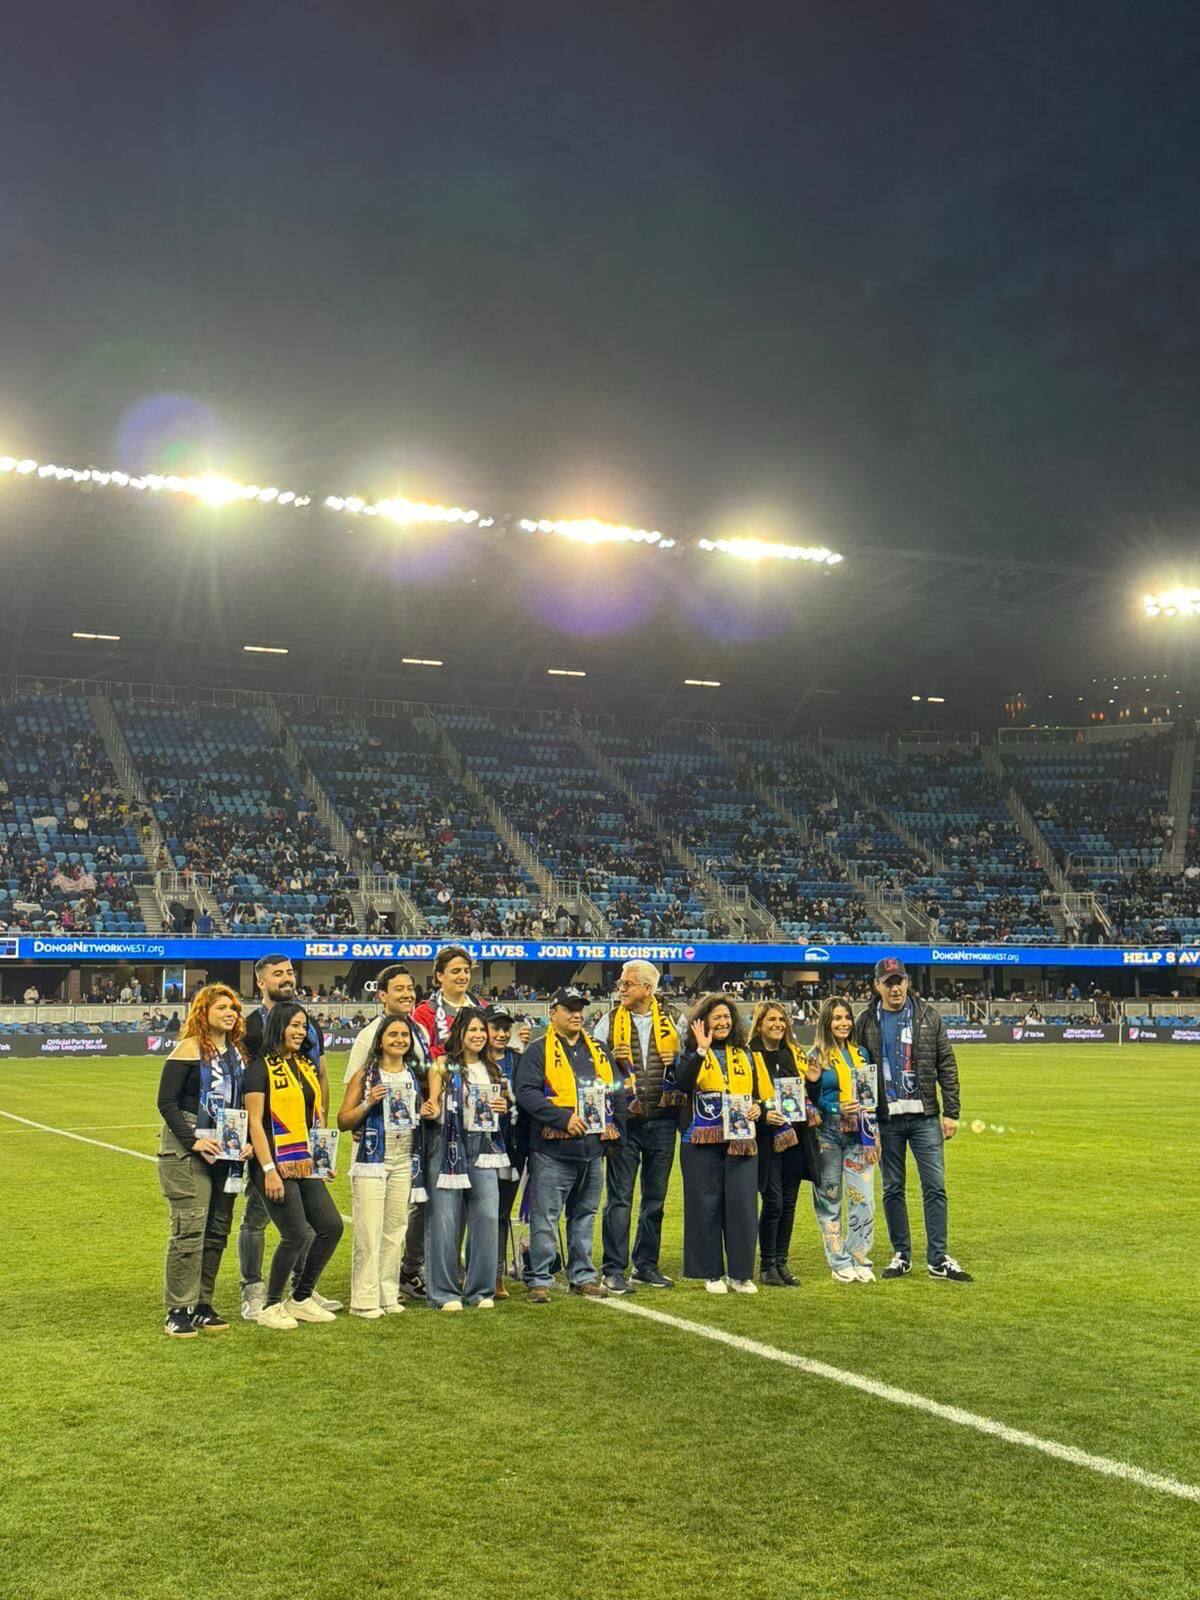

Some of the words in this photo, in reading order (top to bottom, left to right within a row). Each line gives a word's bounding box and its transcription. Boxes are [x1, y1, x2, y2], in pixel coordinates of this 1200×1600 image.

[305, 944, 348, 957] HELP
[352, 944, 393, 957] SAVE
[397, 944, 432, 957] AND
[481, 944, 528, 958] LIVES.
[537, 946, 572, 959] JOIN
[576, 946, 606, 959] THE
[610, 946, 683, 959] REGISTRY!
[1123, 952, 1163, 964] HELP
